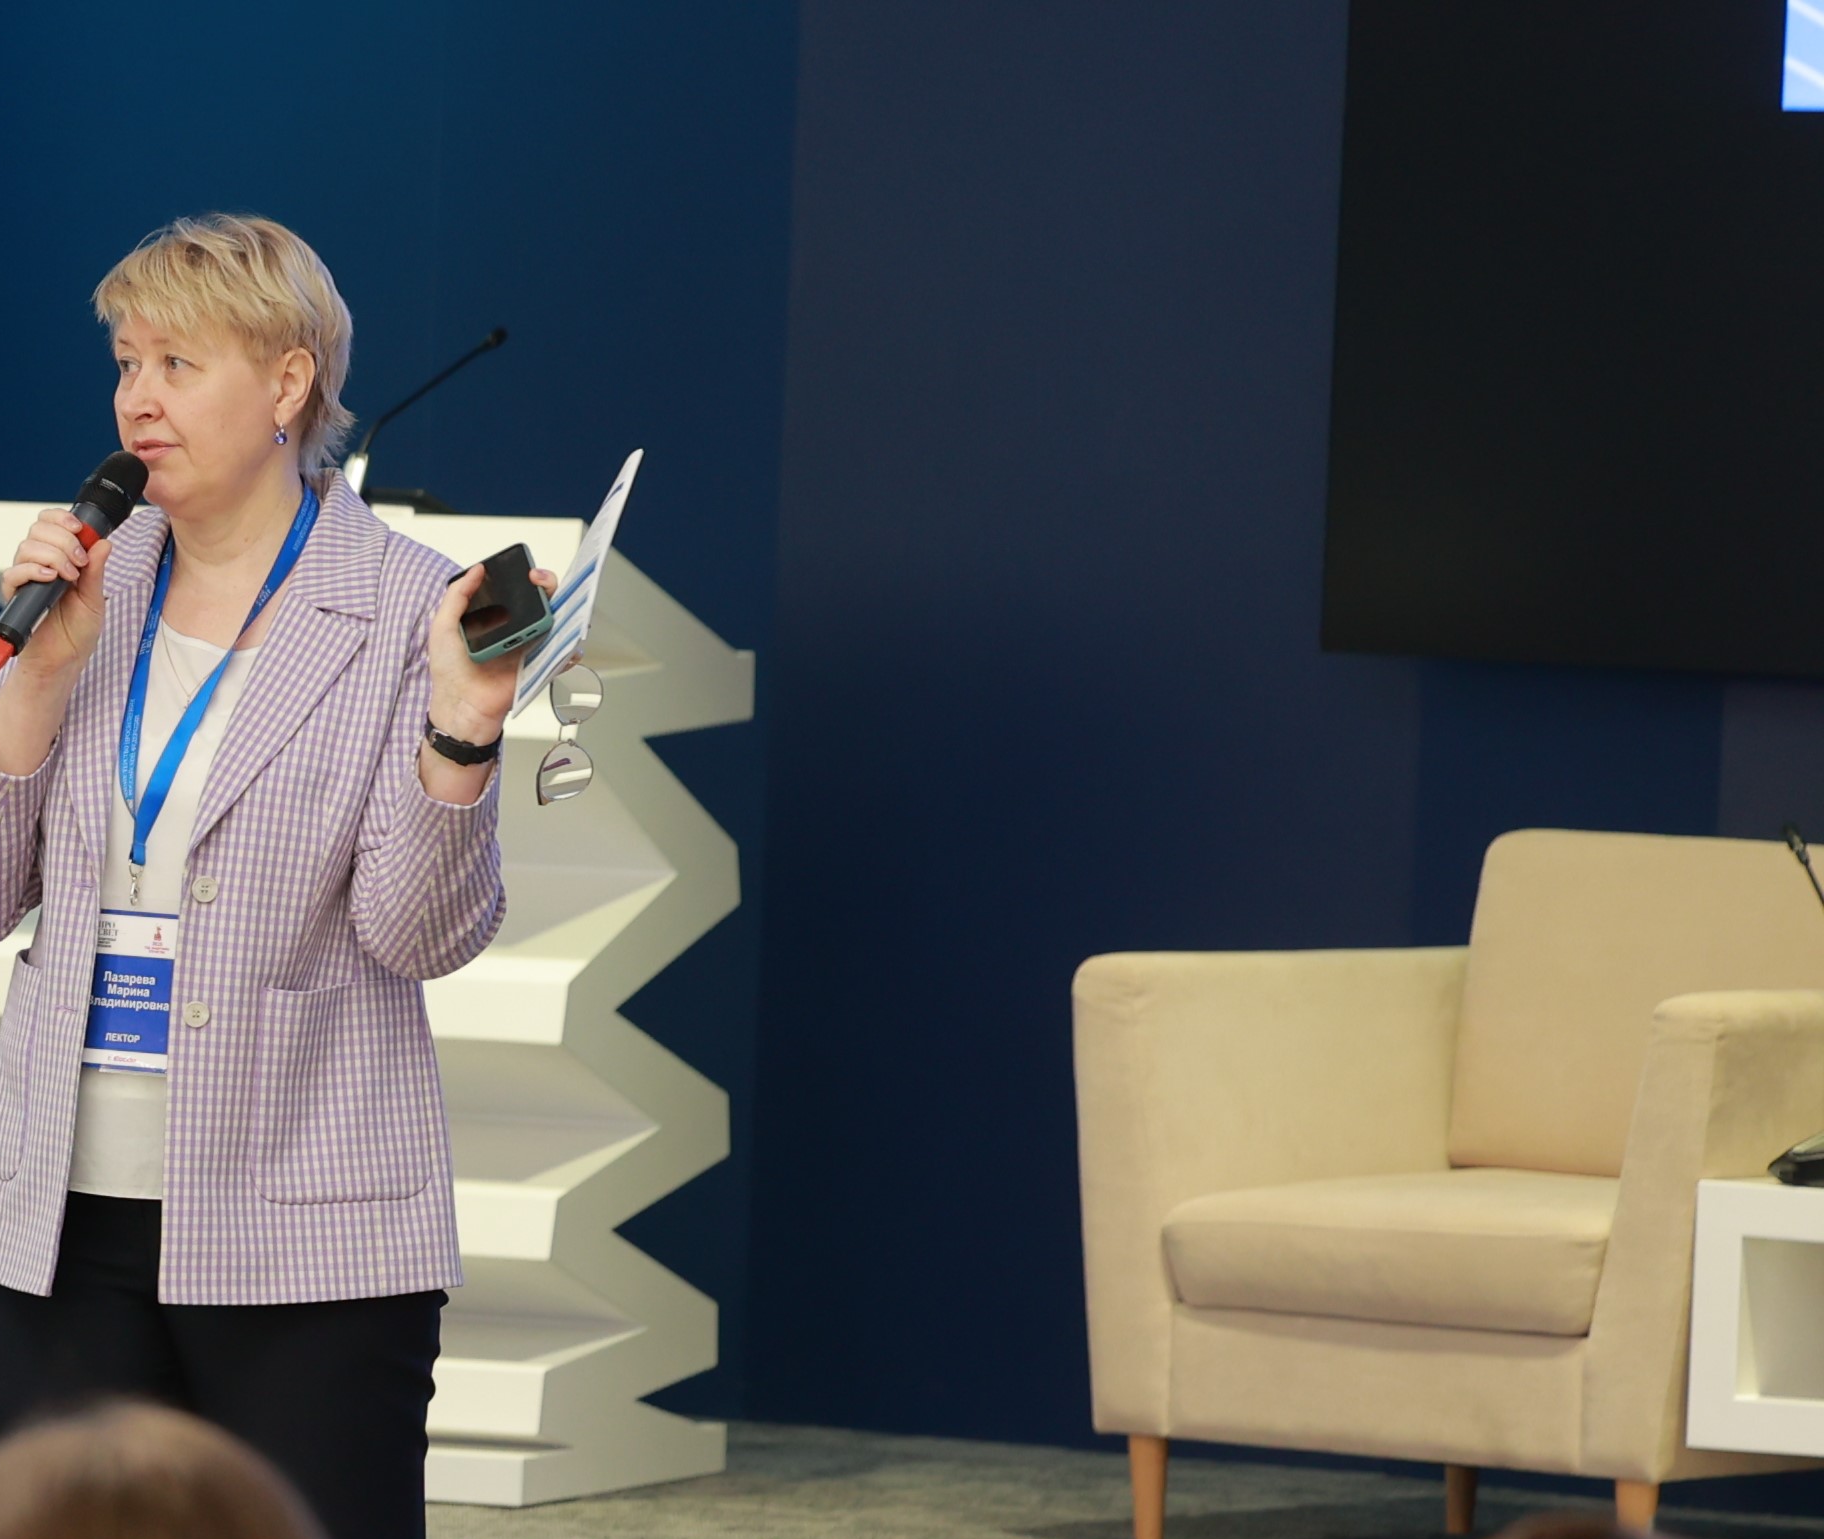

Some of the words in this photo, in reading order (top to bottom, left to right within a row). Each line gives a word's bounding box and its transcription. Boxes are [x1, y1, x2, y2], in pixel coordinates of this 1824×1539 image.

[103, 970, 156, 986] Лазарева
[107, 983, 150, 998] Марина
[105, 1032, 141, 1043] ЛЕКТОР
